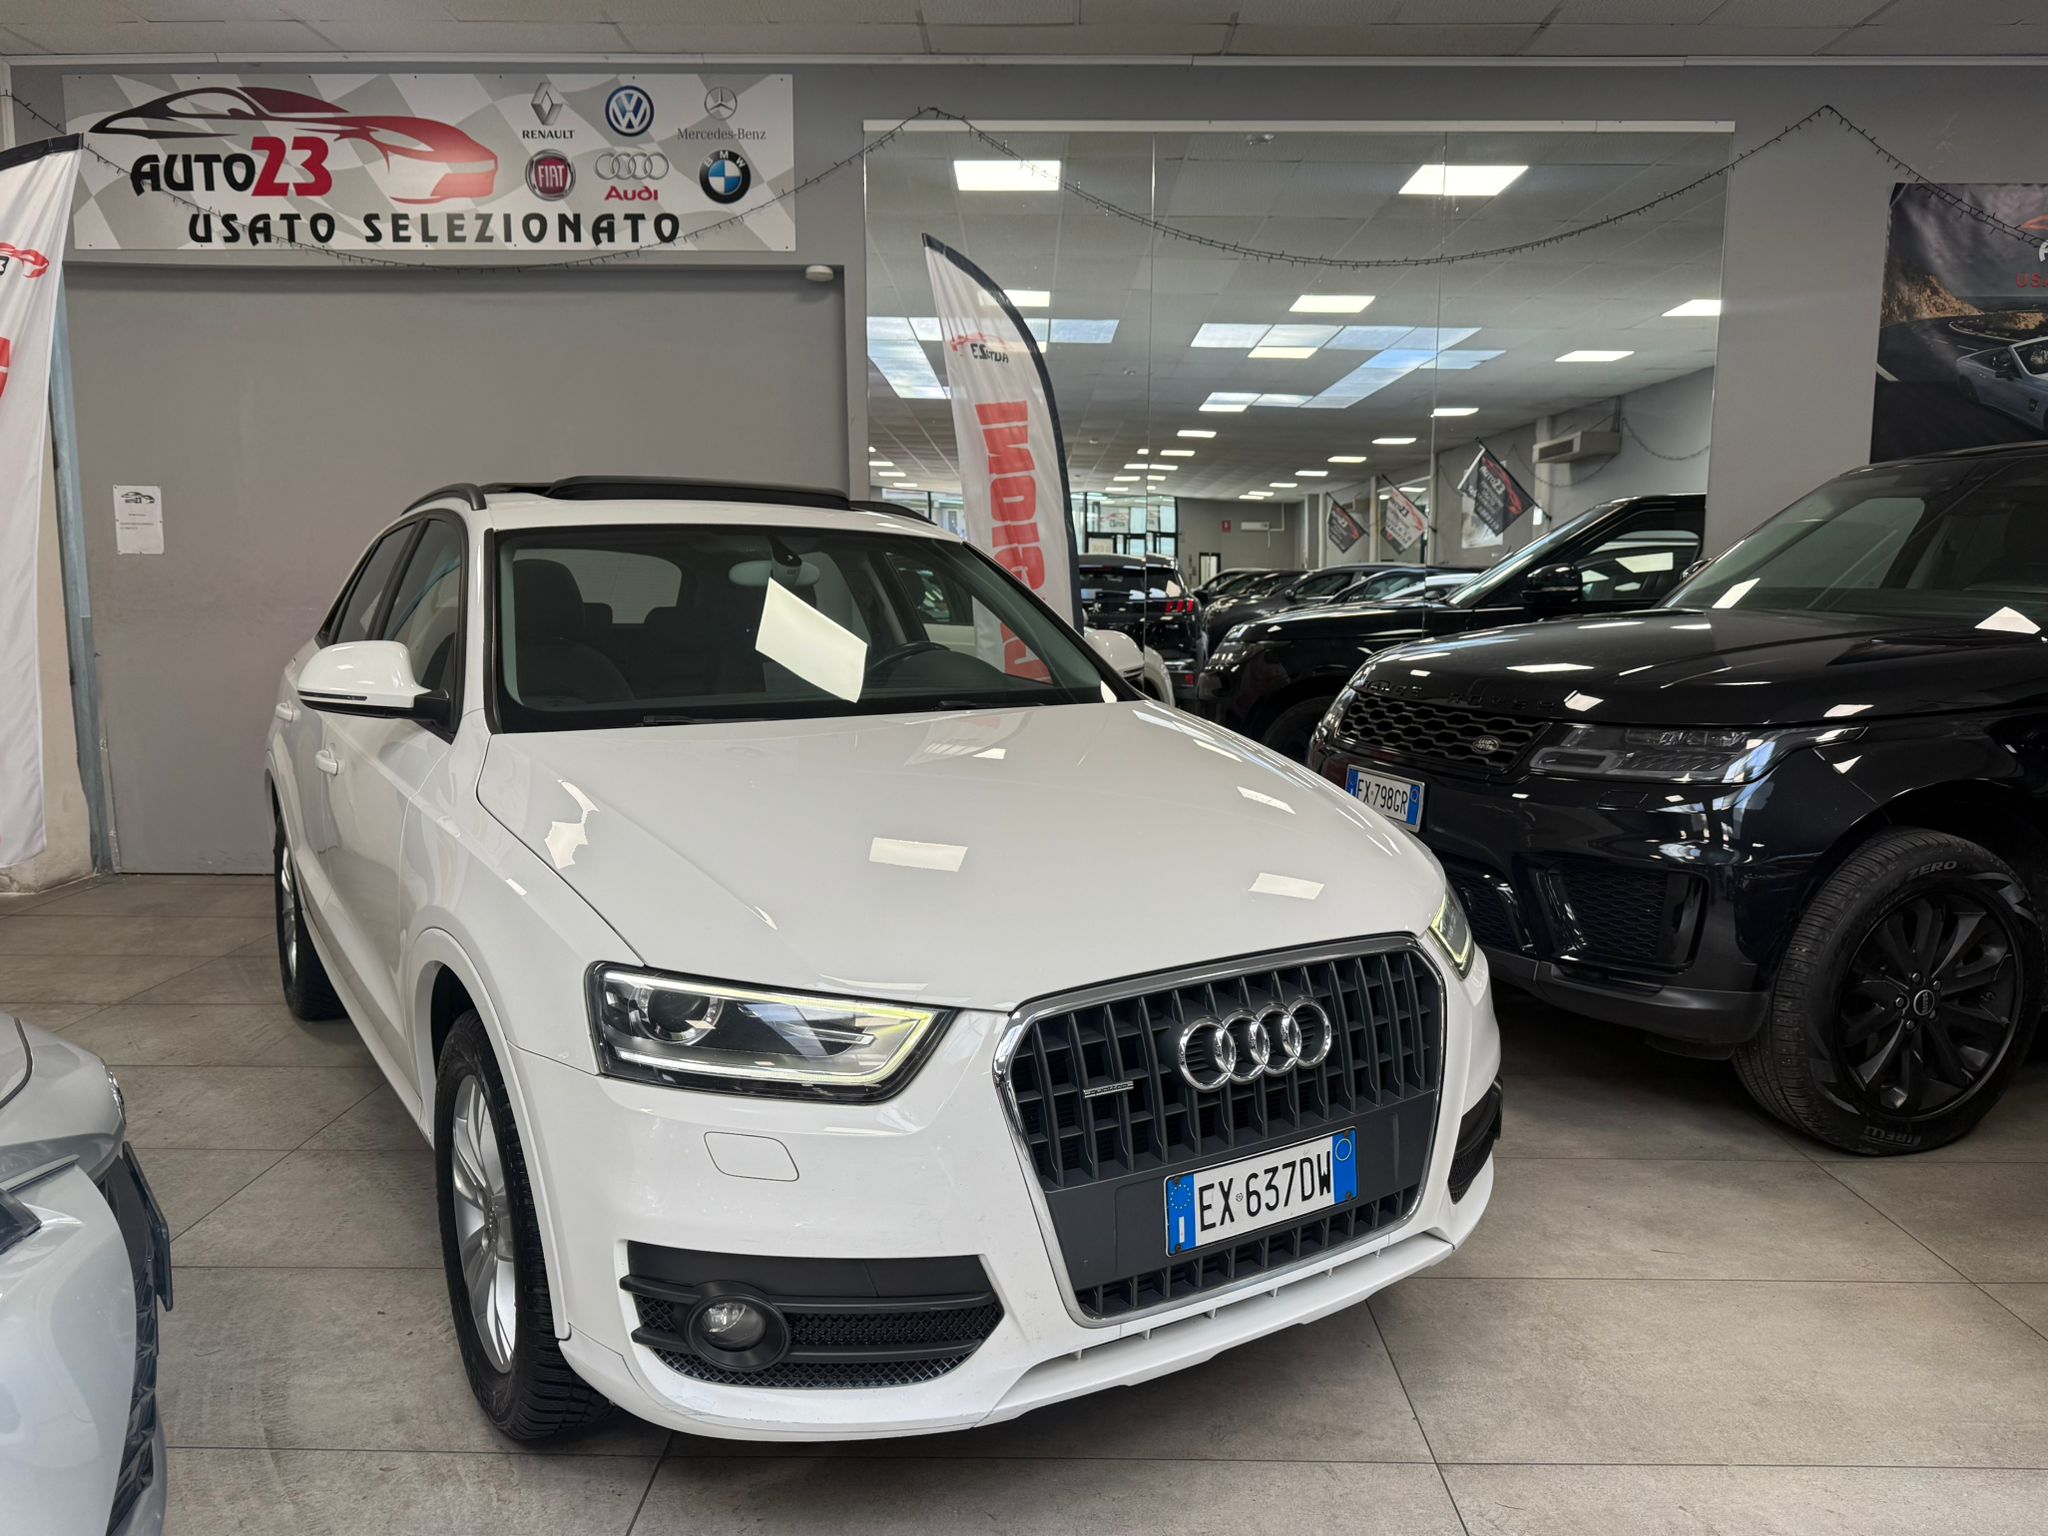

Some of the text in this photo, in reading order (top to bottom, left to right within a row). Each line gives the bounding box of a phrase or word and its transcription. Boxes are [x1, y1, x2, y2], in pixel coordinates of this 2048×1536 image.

[522, 130, 575, 139] RENAULT
[677, 128, 767, 141] Mercedes-Benz
[130, 136, 333, 197] AUTO23
[704, 150, 746, 168] BMW
[537, 164, 565, 188] FIAT
[604, 186, 659, 201] Audi
[188, 212, 680, 247] USATO SELEZIONATO
[1373, 783, 1408, 815] 798GR
[1907, 860, 1958, 883] ZERO
